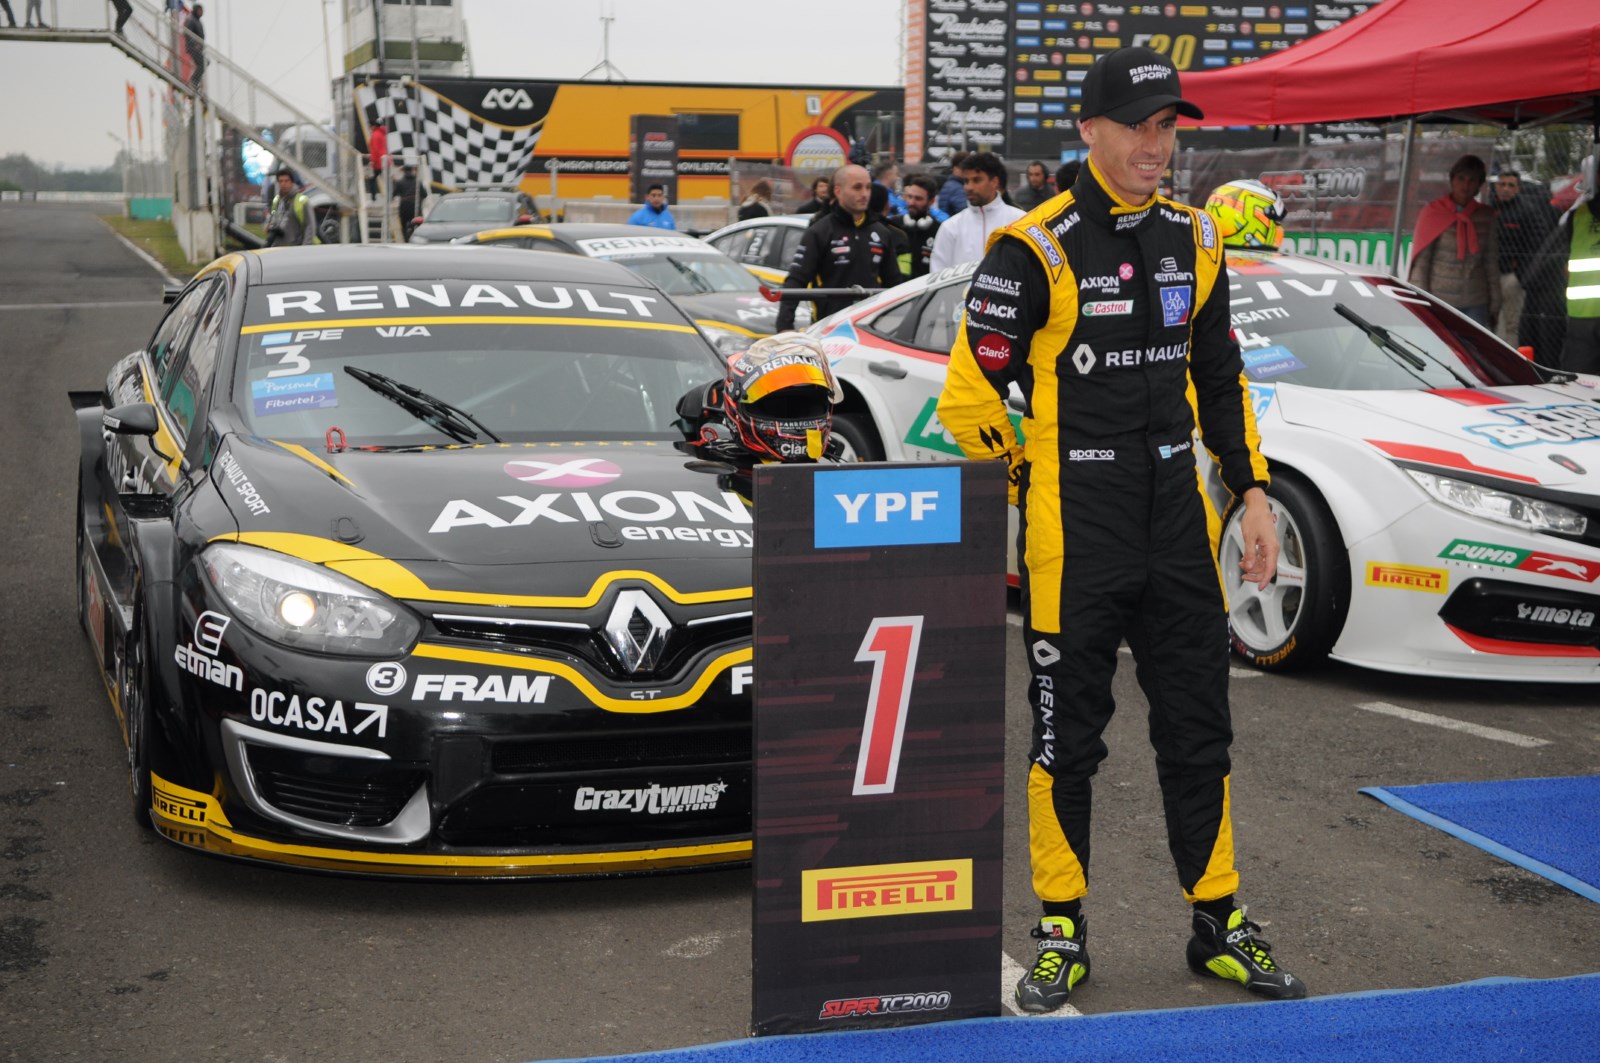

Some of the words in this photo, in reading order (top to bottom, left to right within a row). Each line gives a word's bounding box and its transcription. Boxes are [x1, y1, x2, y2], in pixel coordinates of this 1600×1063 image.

[1129, 64, 1171, 76] RENAULT
[1132, 72, 1168, 84] SPORT
[482, 88, 533, 110] ACA
[1052, 212, 1080, 238] FRAM
[1160, 208, 1190, 224] FRAM
[978, 274, 1021, 290] RENAULT
[1080, 276, 1119, 290] AXION
[266, 284, 656, 319] RENAULT
[1168, 291, 1181, 301] LA
[1094, 302, 1126, 314] Castrol
[265, 344, 311, 378] 3
[977, 346, 1004, 359] Claro
[761, 355, 822, 374] RENAUL
[265, 378, 321, 394] Personal
[265, 396, 313, 409] Fibertel
[781, 443, 808, 455] Clar
[1069, 449, 1115, 461] sparco
[218, 450, 246, 488] RENAULT
[236, 484, 270, 516] SPORT
[428, 490, 753, 533] AXION
[834, 491, 939, 523] YPF
[621, 525, 753, 548] energy
[1449, 543, 1518, 565] PUMA
[1372, 566, 1441, 589] PIRELLI
[175, 642, 244, 692] etman
[411, 675, 550, 703] FRAM
[251, 688, 348, 735] OCASA
[852, 615, 924, 796] 1
[1035, 674, 1056, 766] RENAUL
[817, 870, 958, 911] PIRELLI
